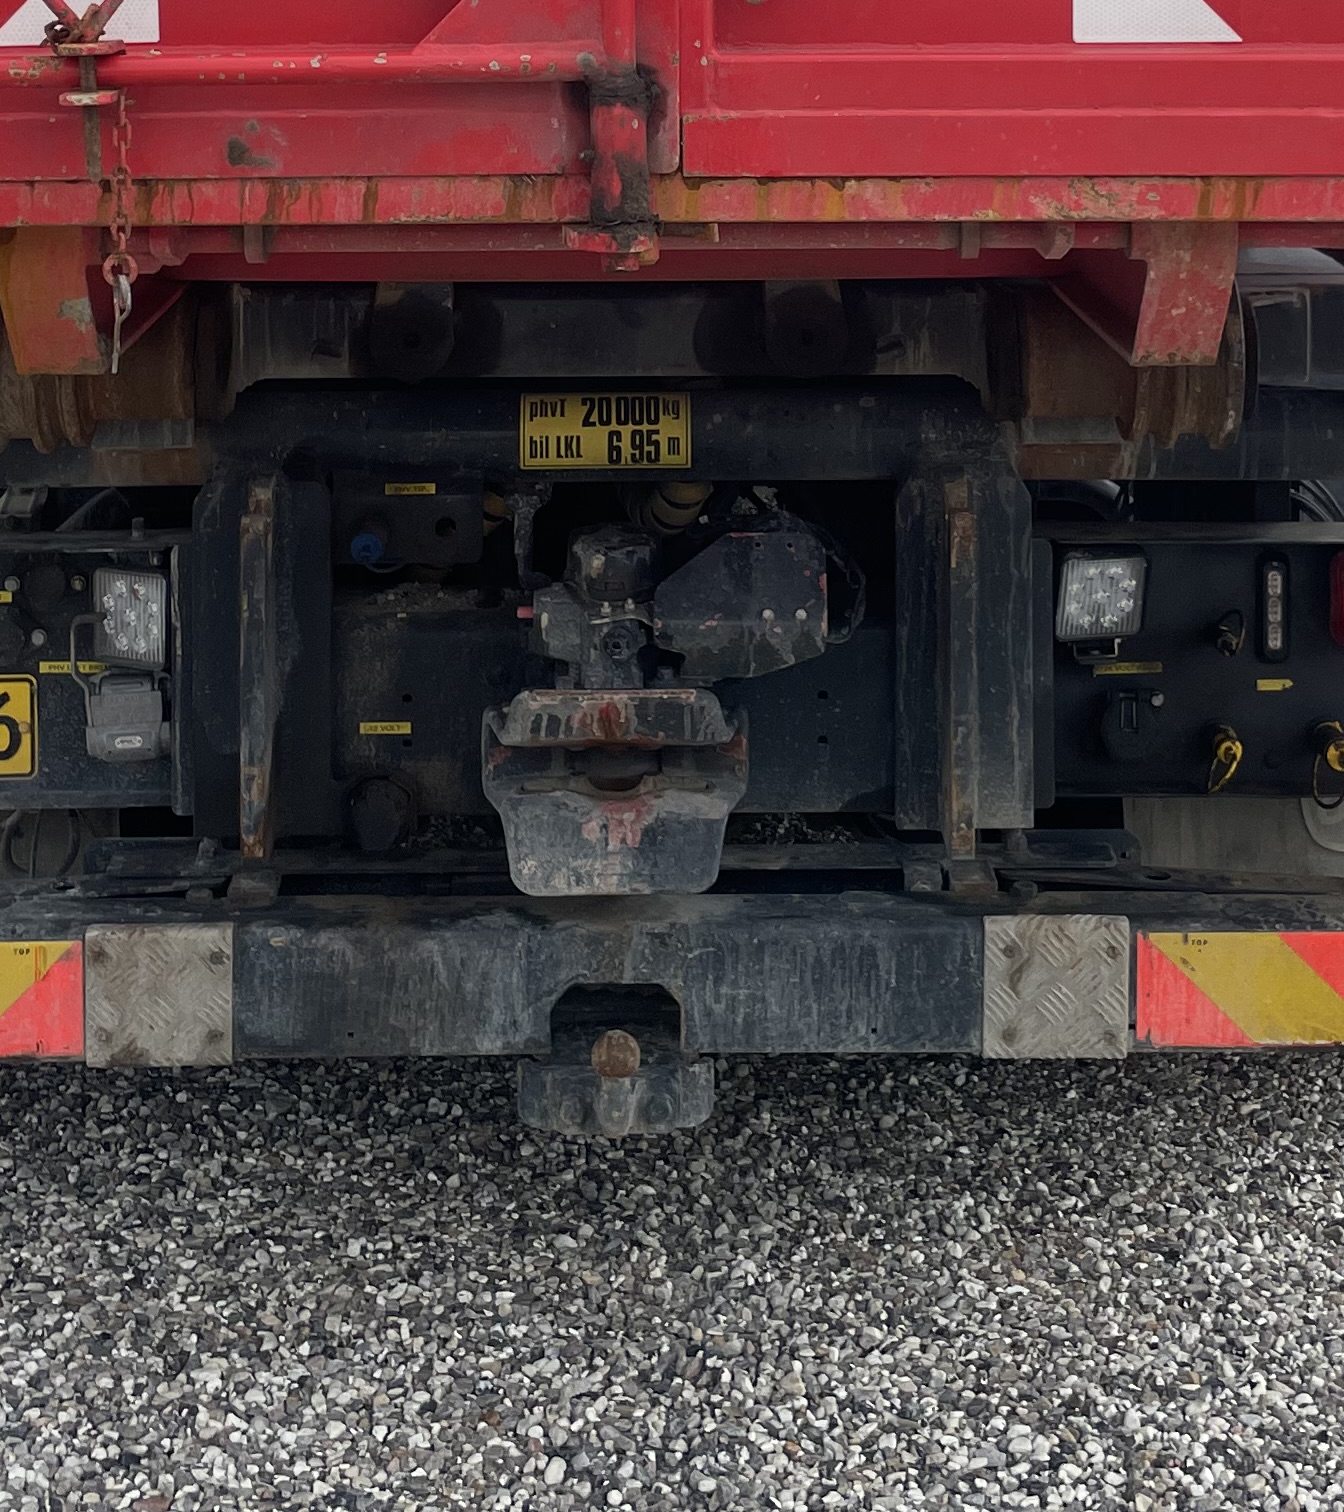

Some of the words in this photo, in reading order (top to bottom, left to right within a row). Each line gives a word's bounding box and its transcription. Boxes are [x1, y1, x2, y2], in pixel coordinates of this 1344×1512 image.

[529, 398, 567, 422] phvT
[662, 397, 680, 420] kg
[529, 435, 549, 459] bil
[556, 435, 583, 459] LKL
[667, 437, 680, 455] m
